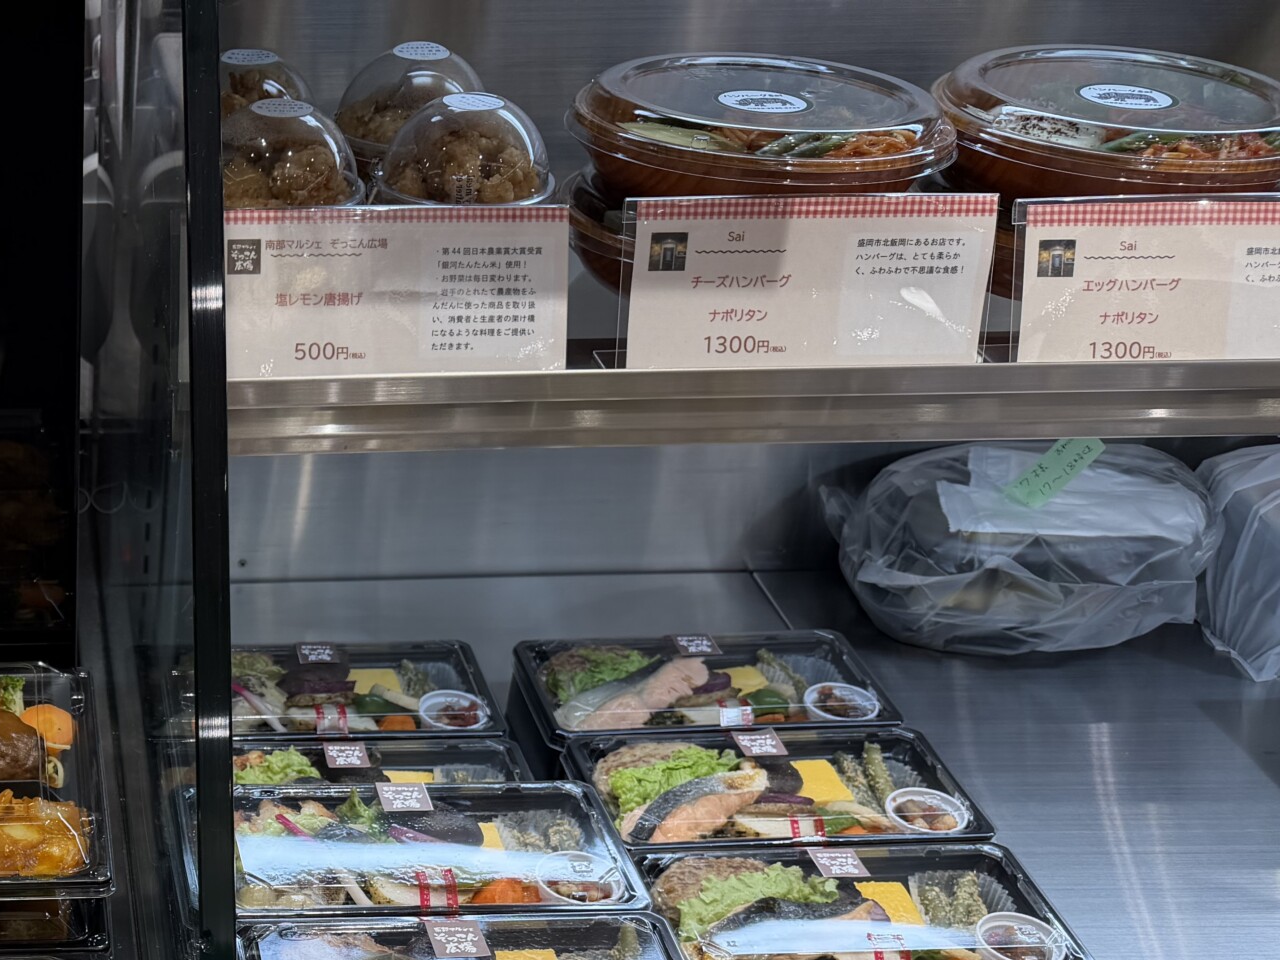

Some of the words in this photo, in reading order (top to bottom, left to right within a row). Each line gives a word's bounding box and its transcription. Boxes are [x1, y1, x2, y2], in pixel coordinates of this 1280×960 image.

[727, 231, 745, 242] Sai
[265, 239, 322, 251] 南部マルシェ
[330, 239, 388, 250] ぞっこん広場
[857, 237, 967, 248] 盛岡市北飯岡にあるお店です。
[1120, 241, 1137, 251] Sai
[855, 251, 961, 262] ハンバーグは、とても柔らか
[1246, 247, 1280, 256] 盛岡市北
[855, 265, 965, 276] く、ふわふわで不思議な食感！
[691, 274, 791, 290] チーズハンバーグ
[1082, 278, 1181, 292] エッグハンバーグ
[275, 292, 363, 307] 塩レモン唐揚げ
[432, 301, 536, 311] んだんに使った商品を取り扱
[708, 308, 768, 323] ナポリタン
[1099, 311, 1159, 325] ナポリタン
[431, 328, 535, 338] になるような料理をご提供い
[431, 341, 475, 351] ただきます。
